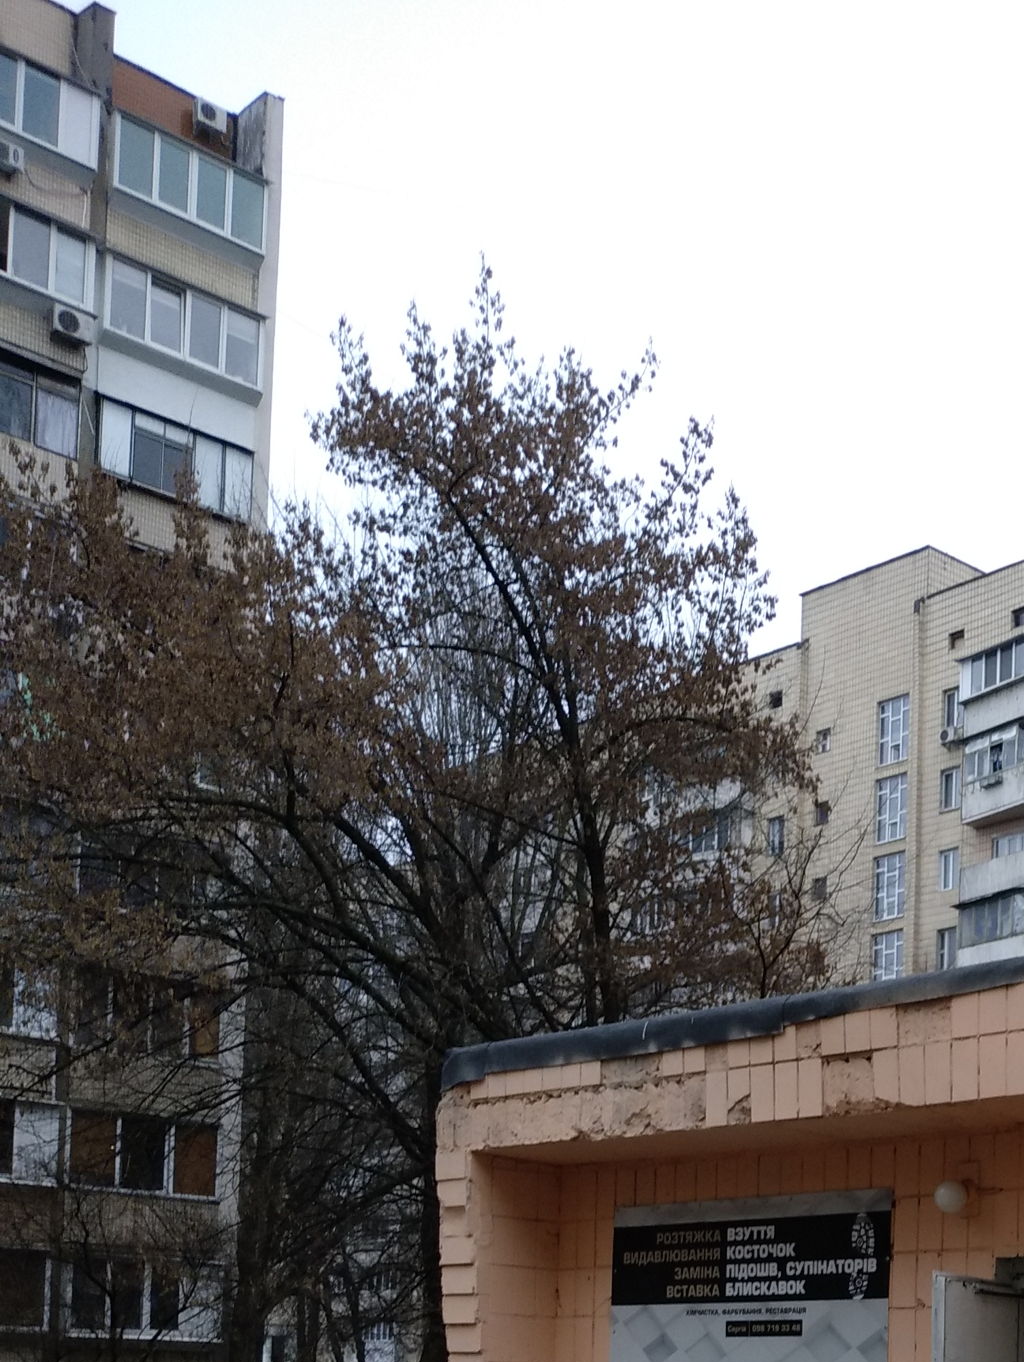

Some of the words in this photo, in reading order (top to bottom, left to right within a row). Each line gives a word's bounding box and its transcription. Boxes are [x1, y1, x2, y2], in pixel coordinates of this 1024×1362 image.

[656, 1230, 721, 1245] РОЗТЯЖКА
[727, 1225, 775, 1242] ВЗУТТЯ
[623, 1247, 721, 1265] ВИДАВЛЮВАННЯ
[726, 1243, 796, 1260] КОСТОЧОК
[674, 1267, 720, 1280] ЗАМІНА
[726, 1262, 781, 1280] ПІДОШВ,
[786, 1258, 877, 1276] СУПІНАТОРІВ
[666, 1284, 720, 1298] ВСТАВКА
[725, 1280, 805, 1297] БЛИСКАВОК
